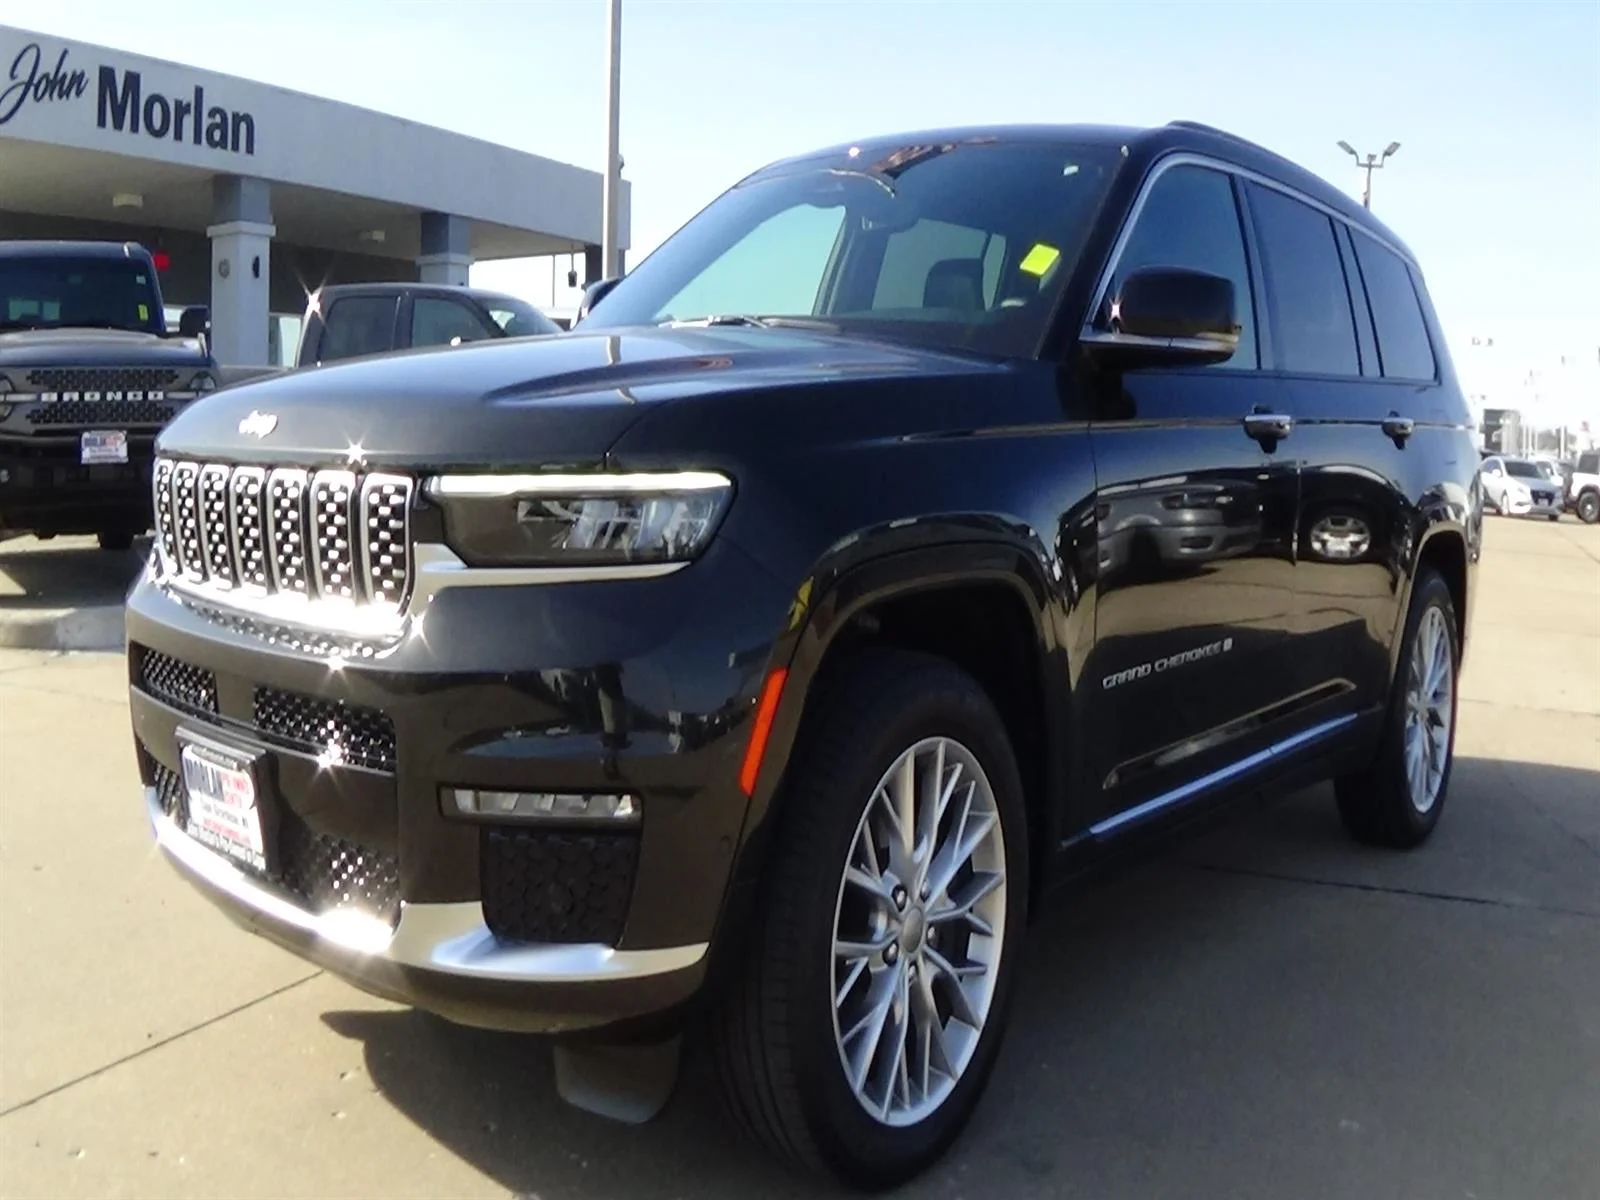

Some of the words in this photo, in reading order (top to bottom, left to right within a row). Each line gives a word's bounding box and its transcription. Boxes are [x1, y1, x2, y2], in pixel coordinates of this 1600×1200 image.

[0, 43, 89, 124] John
[97, 65, 255, 155] Morlan
[1102, 662, 1151, 689] GRAND
[1154, 641, 1222, 672] CHEROKEE
